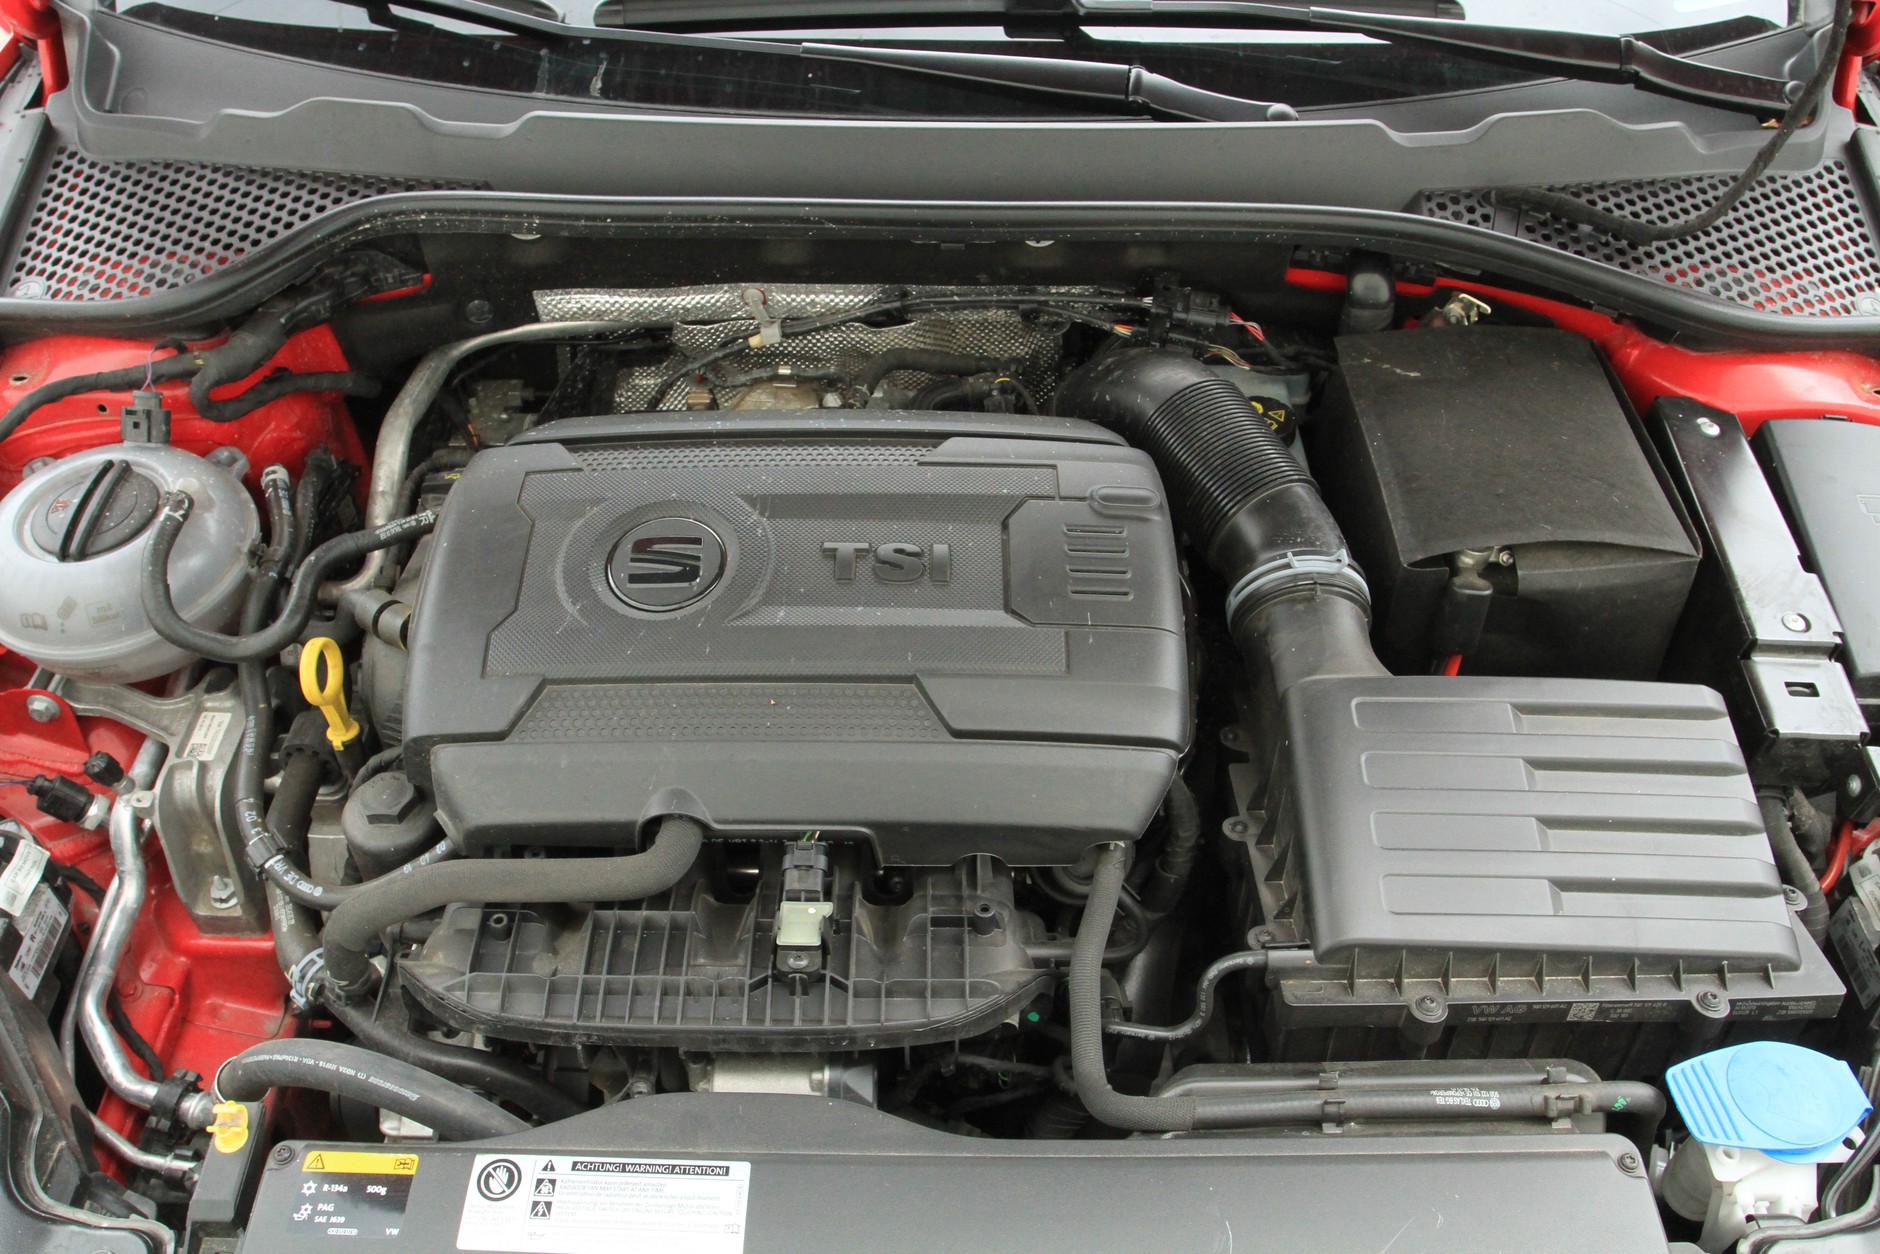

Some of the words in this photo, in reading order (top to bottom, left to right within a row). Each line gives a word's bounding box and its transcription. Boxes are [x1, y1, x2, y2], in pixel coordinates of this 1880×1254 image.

[822, 542, 952, 586] TSI
[1472, 1005, 1500, 1015] VW
[1501, 1004, 1527, 1014] AG
[575, 1162, 623, 1173] ACHTUNG!
[625, 1164, 672, 1174] WARNING!
[673, 1165, 727, 1176] ATTENTION!
[322, 1184, 348, 1193] R-134a
[366, 1185, 388, 1196] 500g
[317, 1203, 335, 1212] PAG
[313, 1215, 328, 1223] SAE
[385, 1228, 400, 1236] VW
